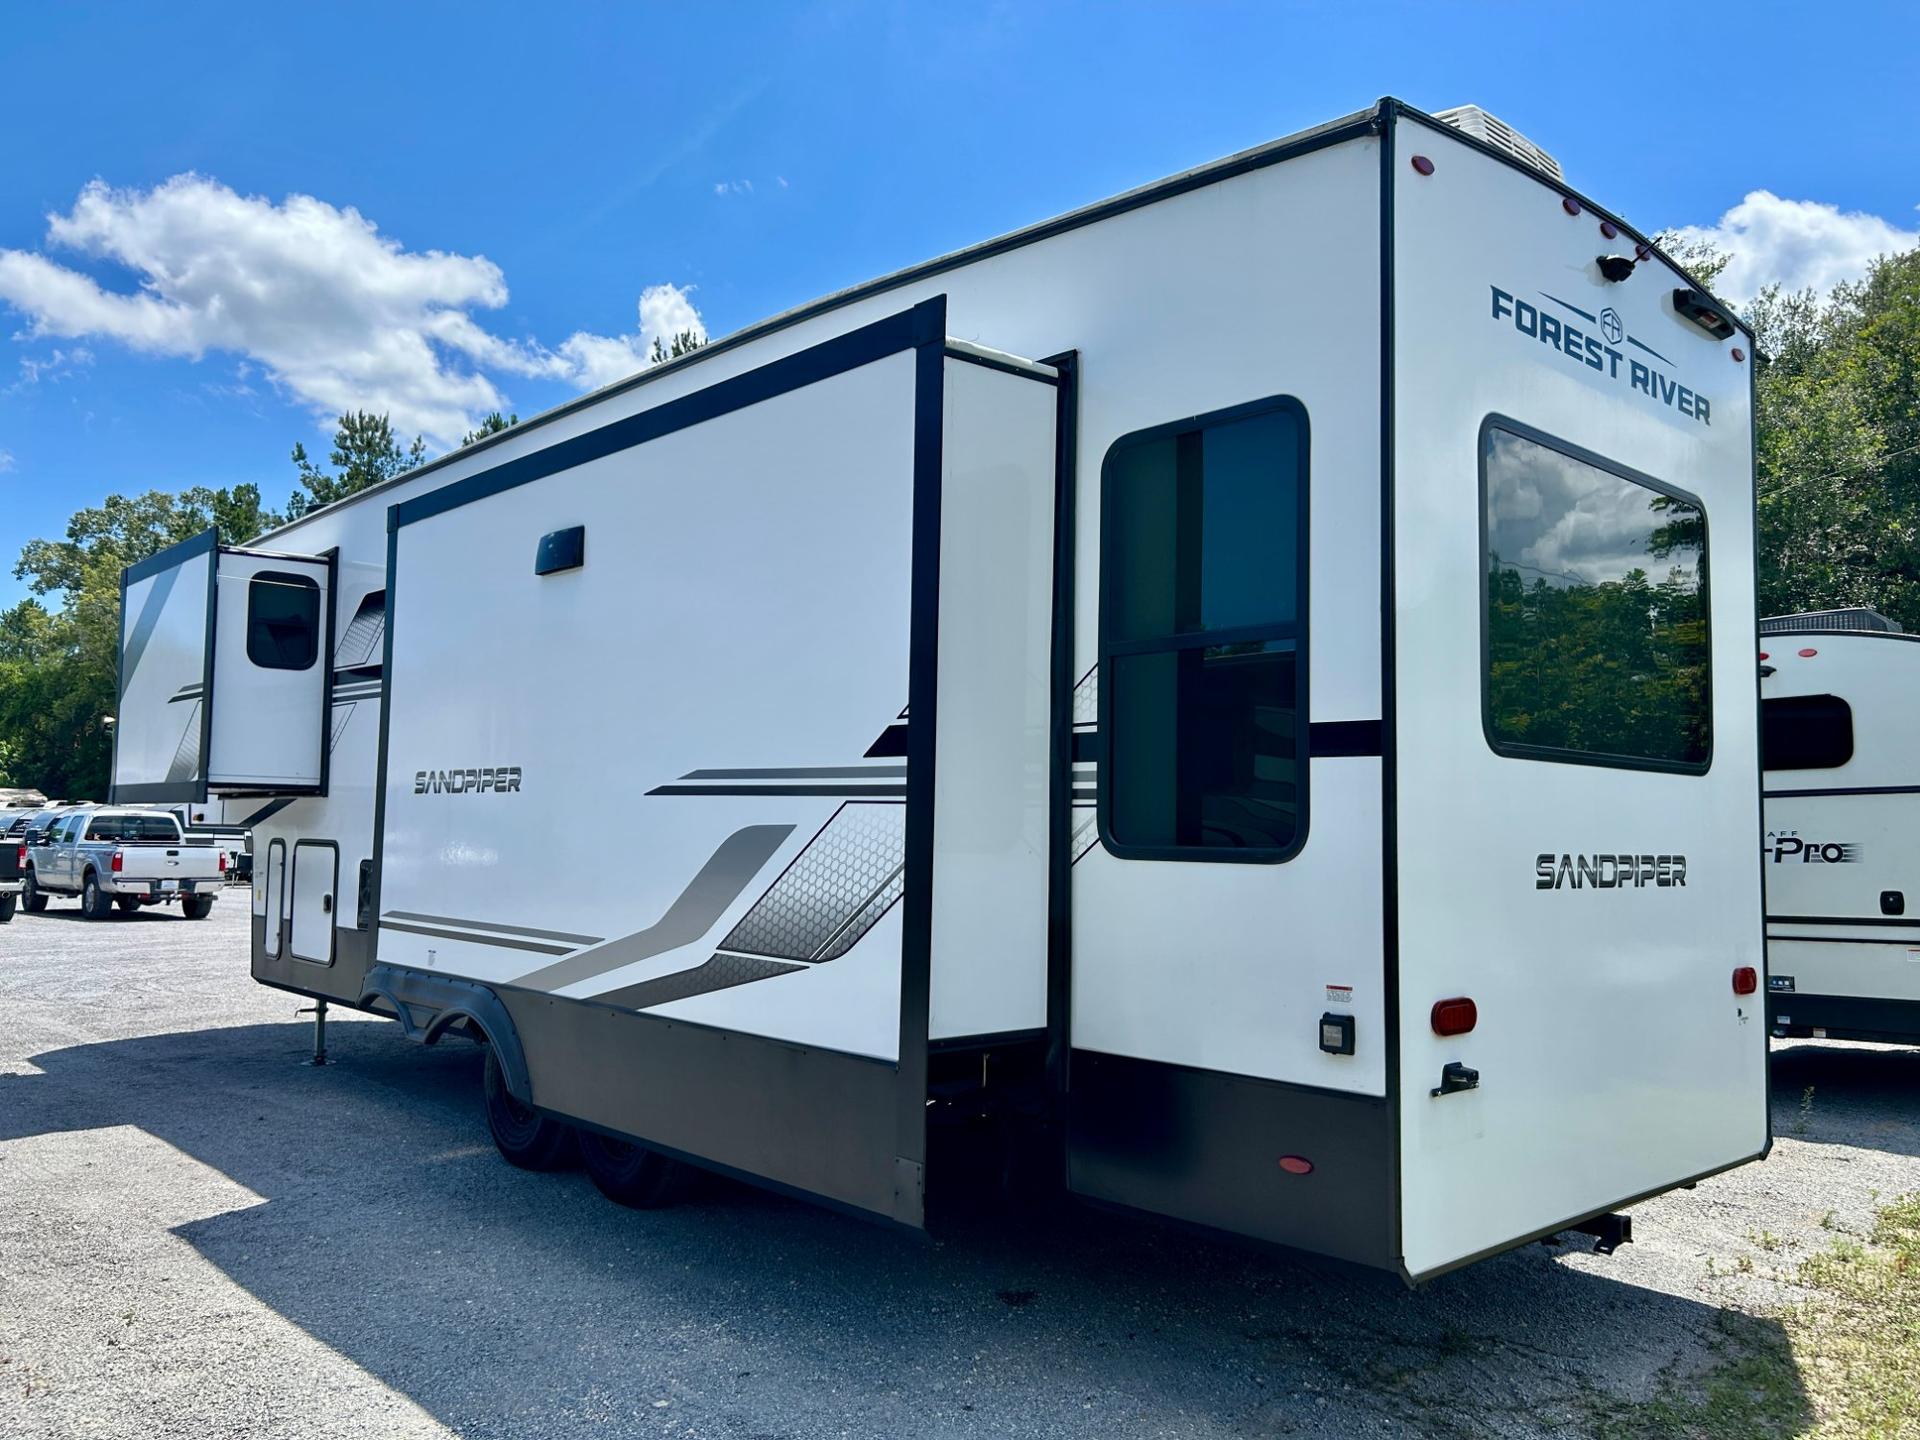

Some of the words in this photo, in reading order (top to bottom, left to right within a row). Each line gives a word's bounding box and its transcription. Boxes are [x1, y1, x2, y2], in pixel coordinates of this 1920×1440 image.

[1490, 285, 1623, 379] FOREST
[1629, 359, 1711, 426] RIVER
[415, 767, 521, 794] SANDPIPER
[1536, 854, 1686, 889] SANDPIPER
